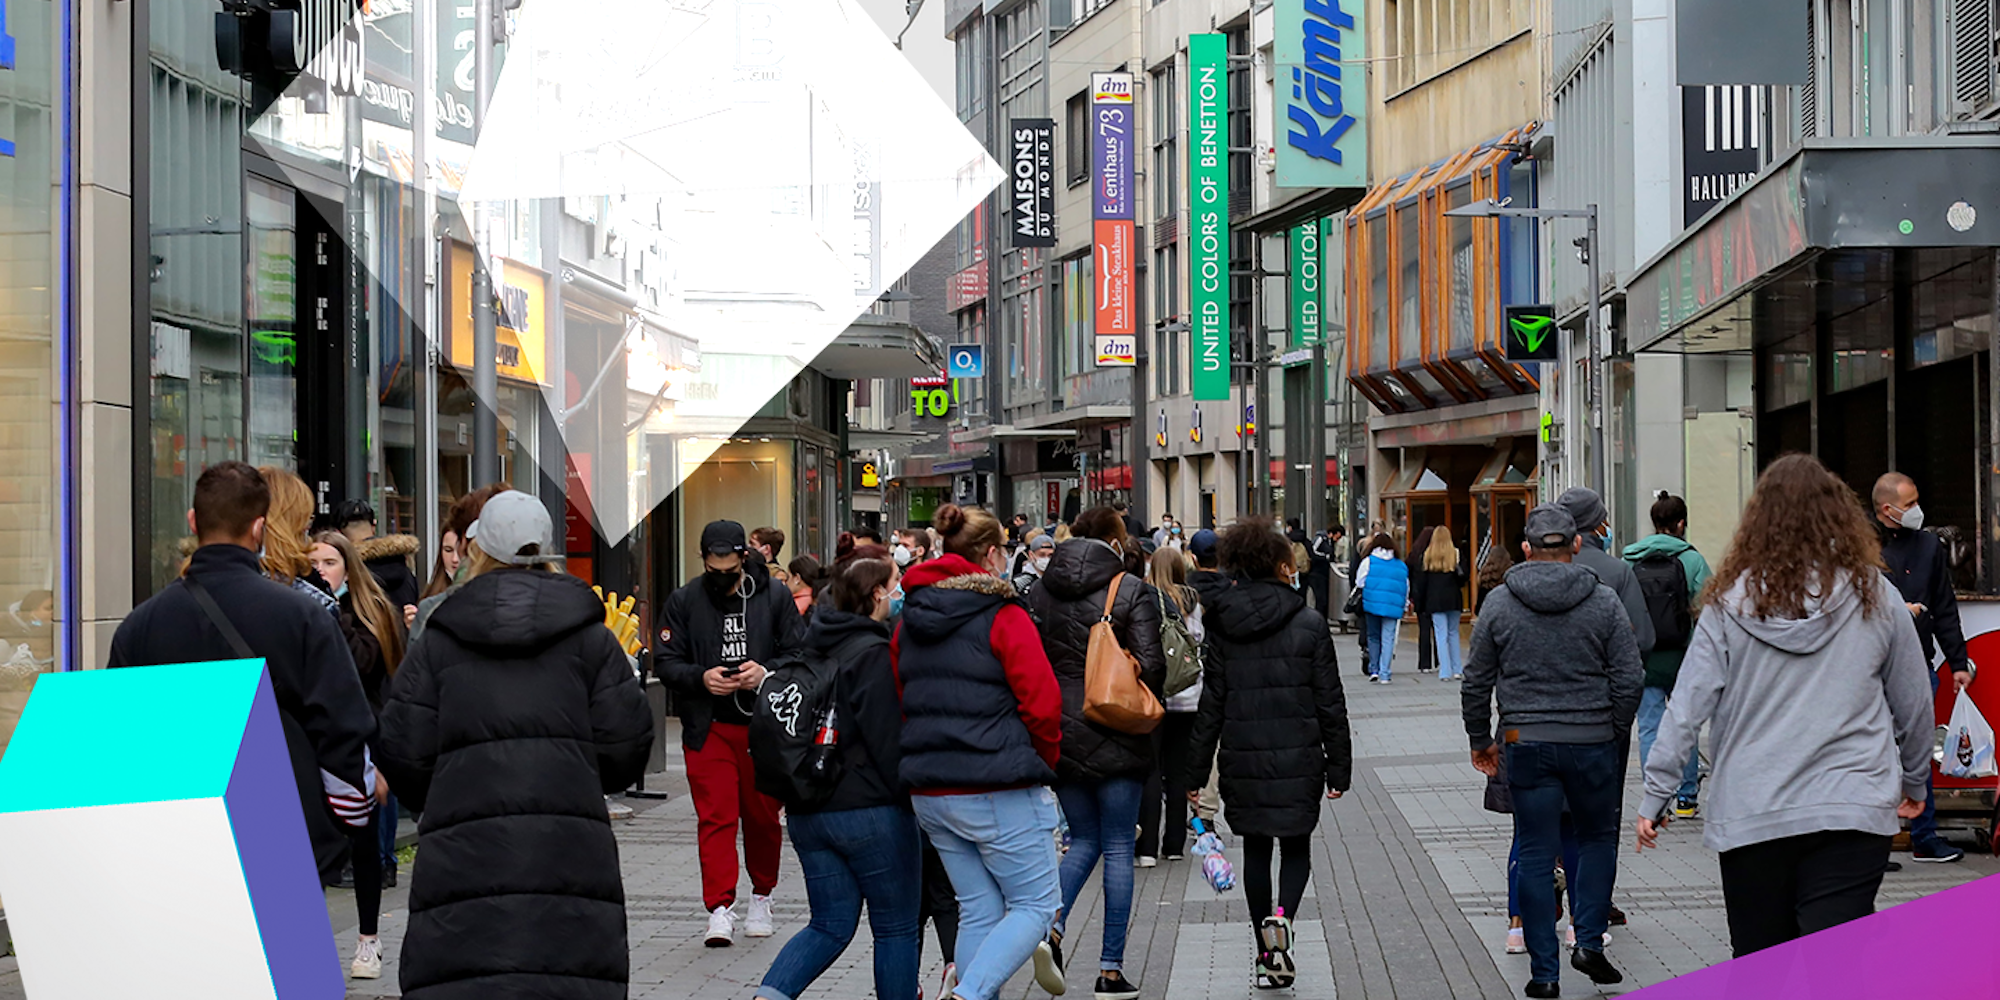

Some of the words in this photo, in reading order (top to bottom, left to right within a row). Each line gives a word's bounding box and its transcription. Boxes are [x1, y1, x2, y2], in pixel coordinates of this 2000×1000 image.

[1101, 77, 1127, 93] dm
[1100, 108, 1124, 136] 73
[1200, 63, 1217, 167] BENETTON.
[1039, 128, 1050, 199] MONDE
[1102, 136, 1118, 214] Eventhaus
[1015, 128, 1034, 237] MAISONS
[1201, 177, 1217, 203] OF
[1040, 213, 1051, 237] DU
[1111, 225, 1122, 275] Steakhaus
[1201, 212, 1219, 292] COLORS
[1112, 276, 1123, 307] kleine
[1112, 313, 1123, 329] Das
[1202, 301, 1220, 371] UNITED
[1104, 339, 1130, 355] dm
[911, 389, 949, 416] TO
